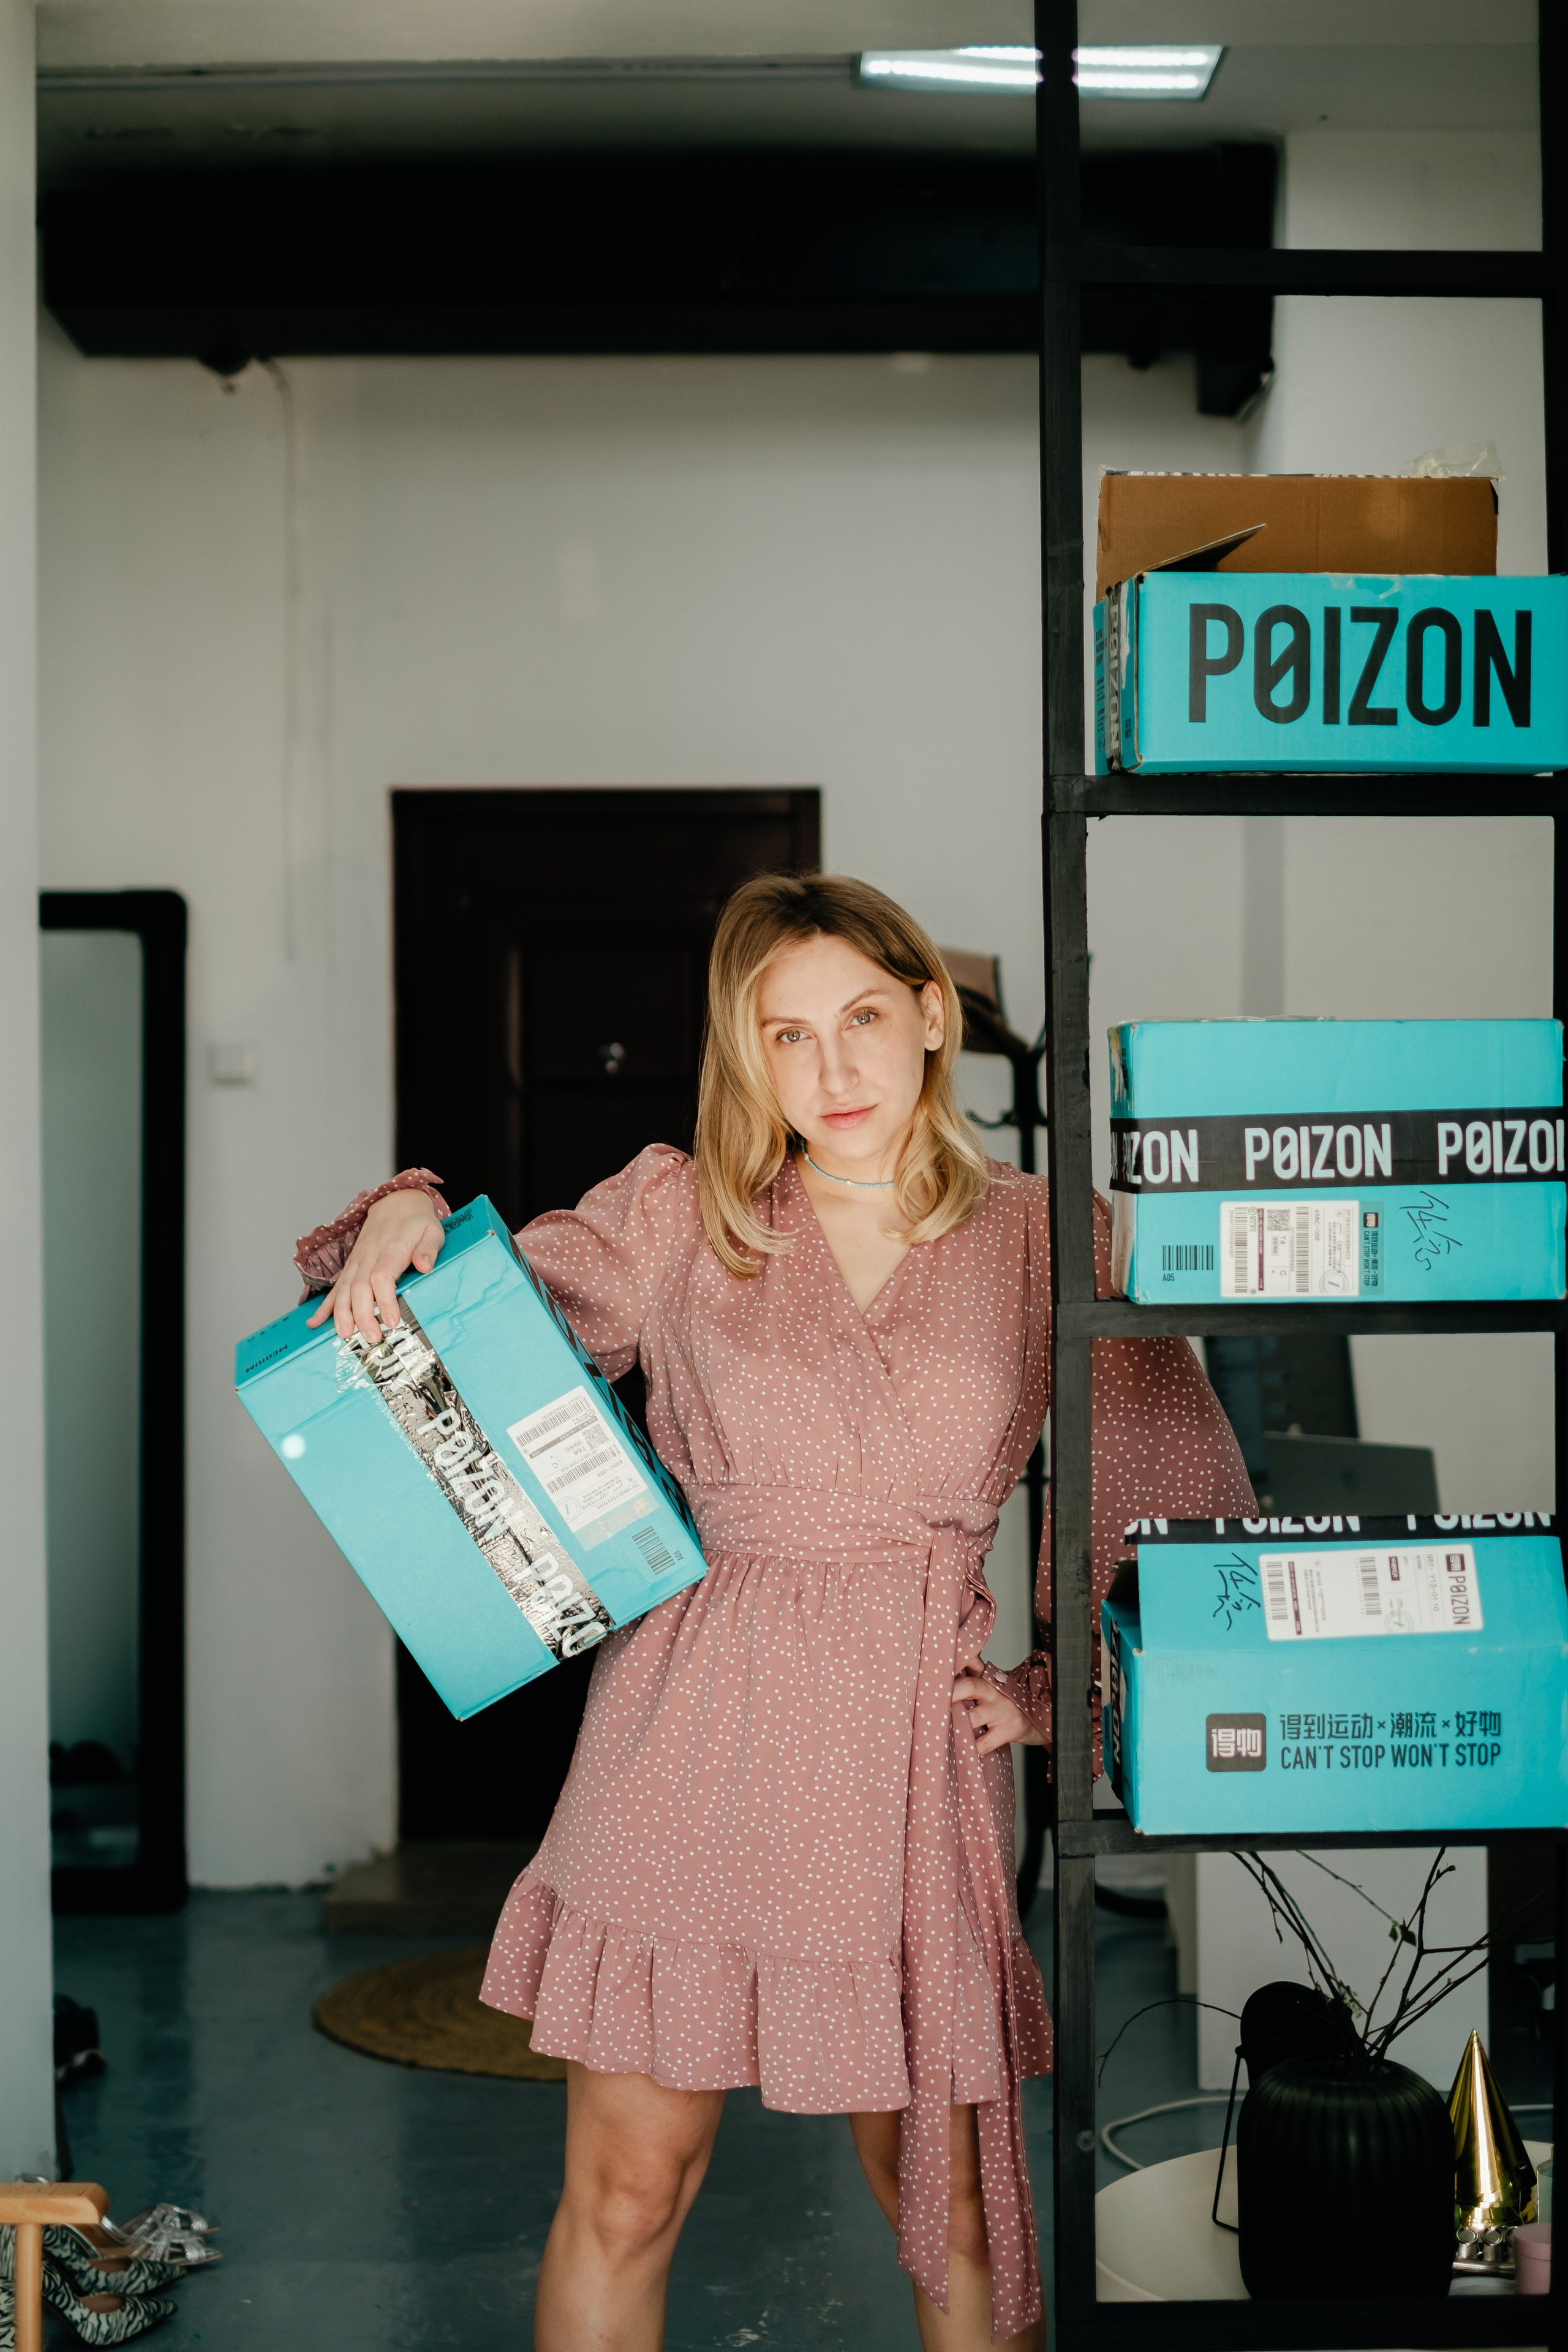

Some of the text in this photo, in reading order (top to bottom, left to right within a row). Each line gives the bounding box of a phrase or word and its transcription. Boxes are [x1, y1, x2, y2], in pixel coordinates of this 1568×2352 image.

[1280, 1235, 1286, 1244] T4
[1162, 1273, 1175, 1281] A05
[246, 1344, 287, 1373] MEDIUM
[573, 1444, 587, 1456] T68
[1211, 1728, 1264, 1758] 得物
[1280, 1742, 1501, 1770] CAN'T STOP WON'T STOP
